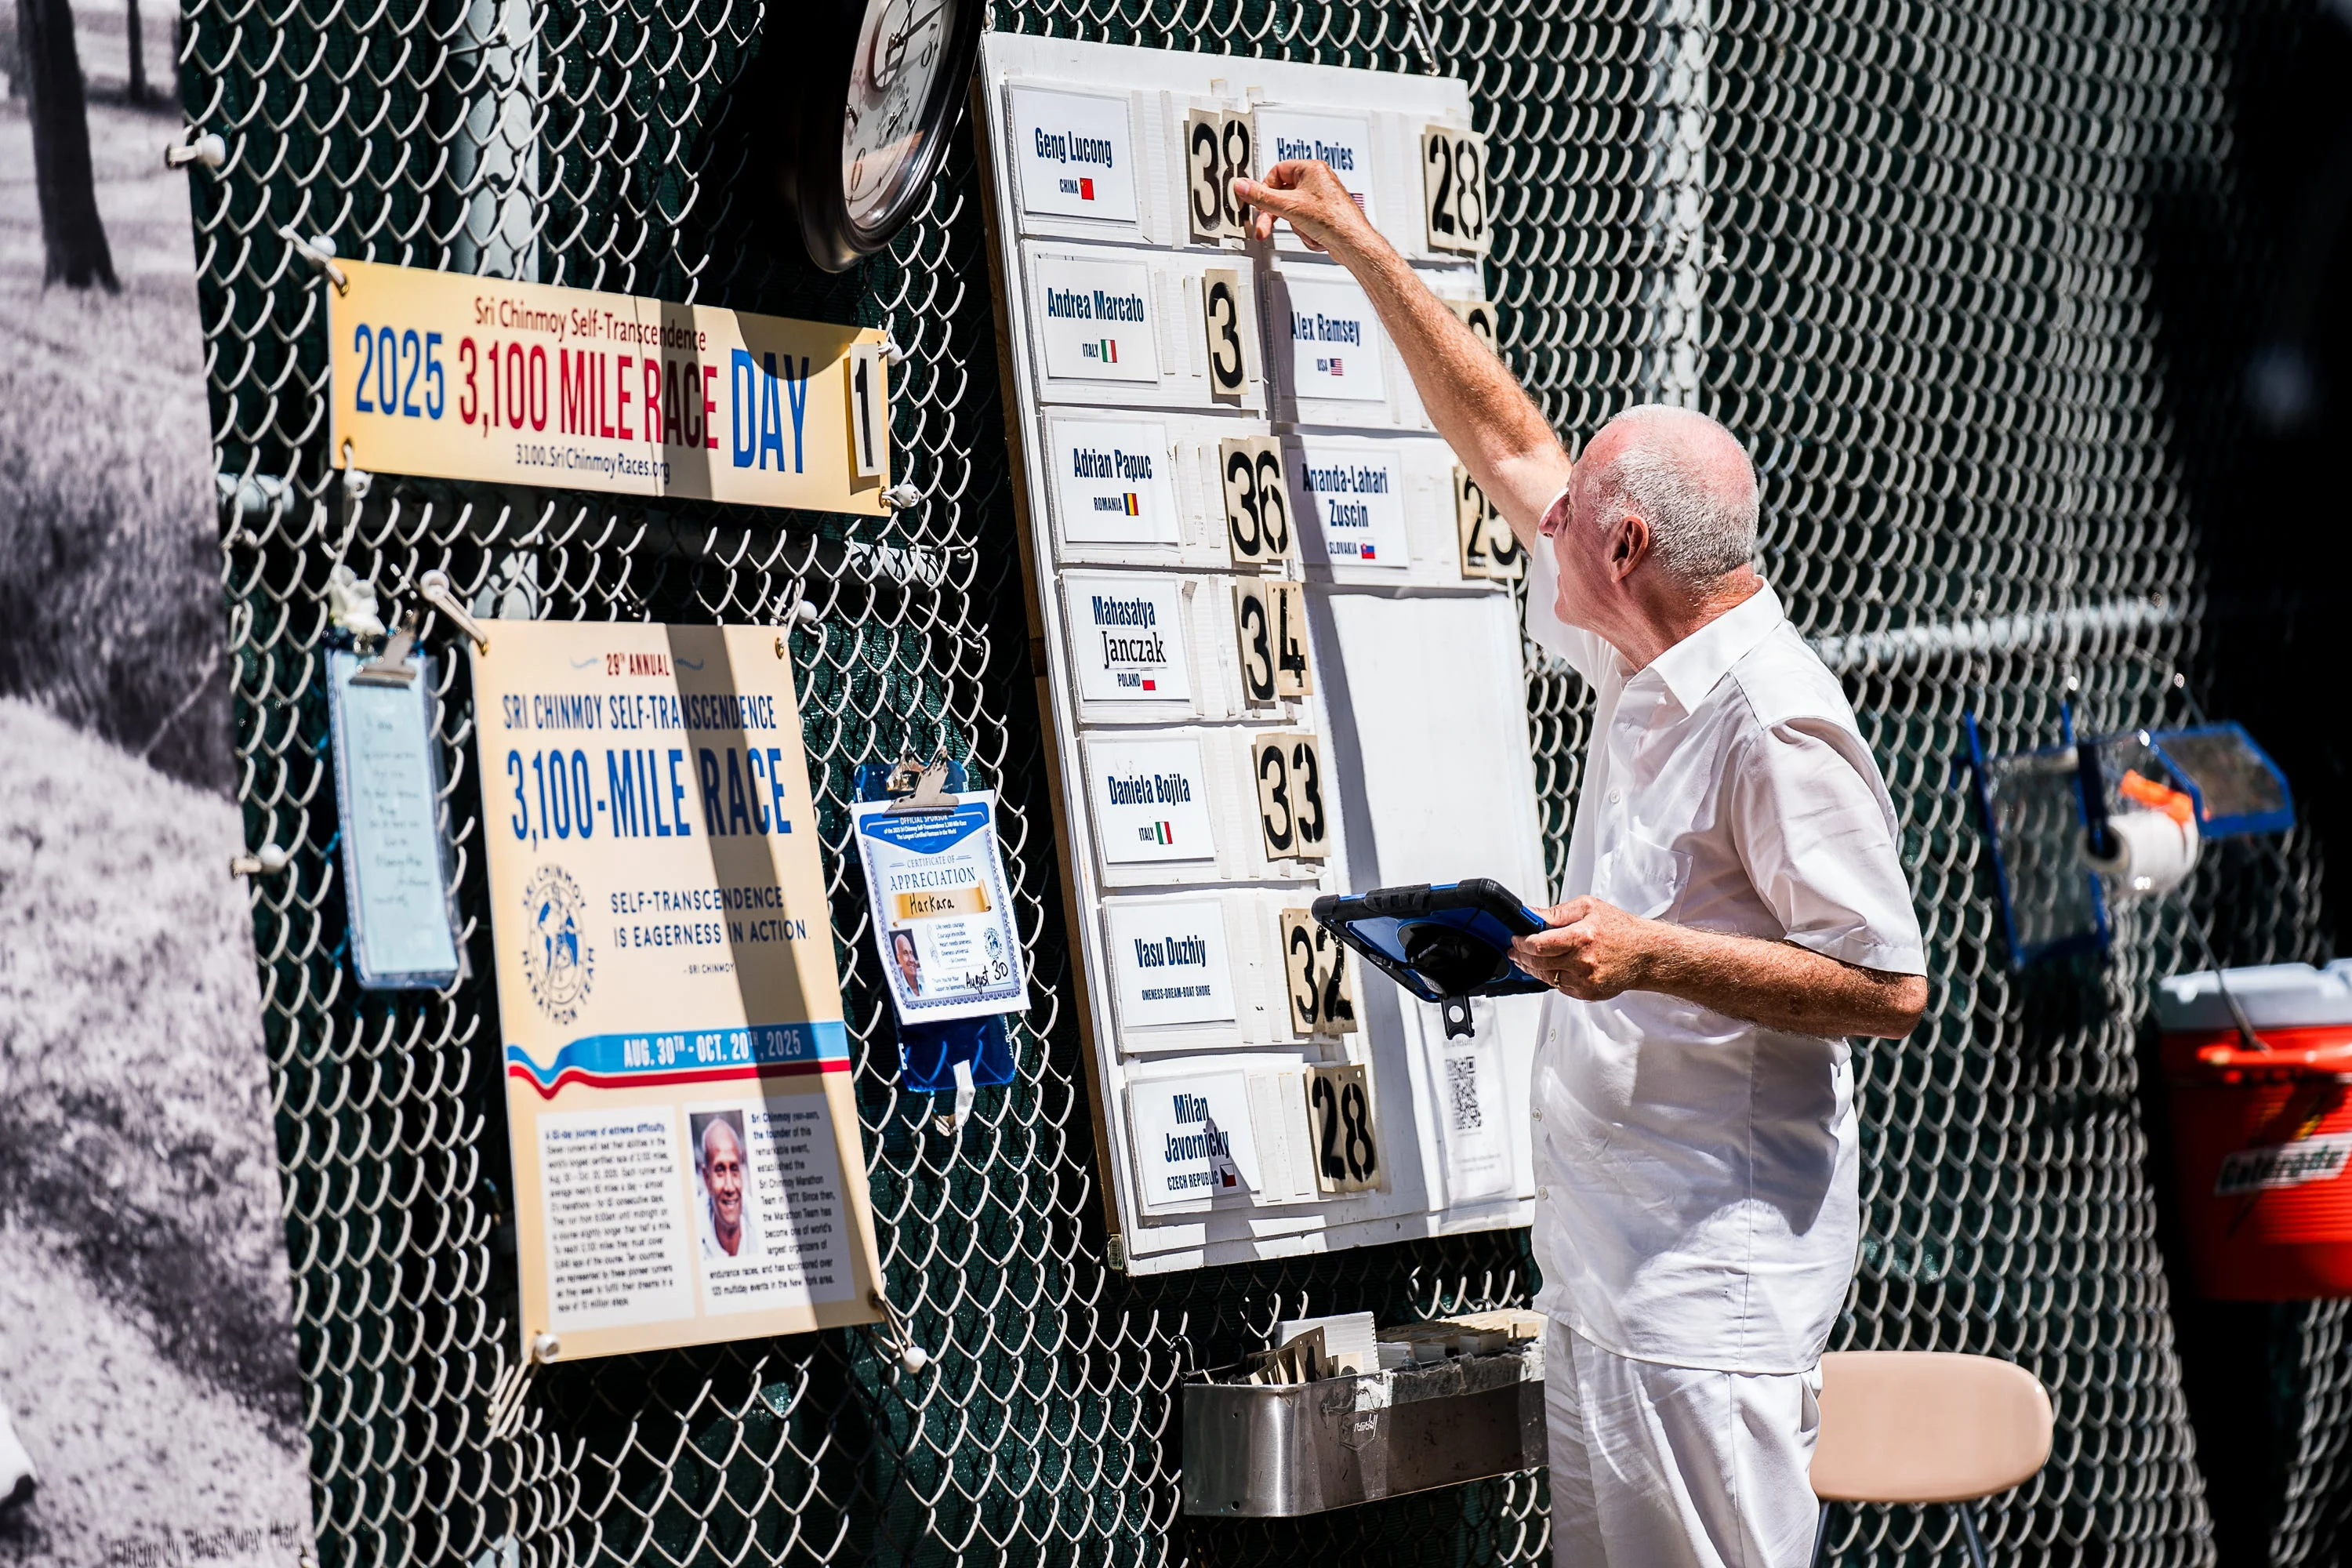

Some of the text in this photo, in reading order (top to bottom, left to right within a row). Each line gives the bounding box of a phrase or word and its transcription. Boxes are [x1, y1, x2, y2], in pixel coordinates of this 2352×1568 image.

[1035, 127, 1112, 169] Geng Lucong
[1276, 137, 1354, 170] Harita Davies
[1059, 178, 1079, 194] CHINA
[1192, 119, 1251, 232] 38
[1428, 134, 1483, 241] 28
[1047, 287, 1145, 322] Andrea Marcato
[474, 296, 707, 352] Sri Chinmoy Self-Transcendence
[1208, 281, 1243, 388] 3
[1290, 311, 1361, 347] Alex Ramsey
[1082, 343, 1098, 358] ITALY
[354, 322, 875, 474] 2025 3,100 MILE RACE DAY 1
[1073, 448, 1152, 483] Adrian Papuc
[1302, 463, 1388, 493] Ananda-Lahari
[1094, 497, 1123, 512] ROMANIA
[1228, 450, 1289, 557] 36
[1329, 499, 1369, 527] Zuscin
[1329, 542, 1358, 555] SLOVAKIA
[1092, 596, 1156, 629] Mahasatya
[1102, 630, 1167, 668] Janczak
[1241, 588, 1307, 700] 34
[630, 653, 670, 677] ANNUAL
[1117, 673, 1141, 688] POLAND
[503, 695, 777, 730] SRI CHINMOY SELF-TRANSCENDENCE
[507, 748, 691, 851] 3,100-MILE
[699, 747, 793, 837] RACE
[1108, 773, 1191, 807] Daniela Bojila
[1259, 742, 1326, 851] 33
[899, 816, 924, 826] OFFICIAL
[1138, 826, 1155, 842] ITALY
[907, 855, 956, 868] CERTIFICATE OF
[891, 866, 976, 891] APPRECIATION
[612, 887, 784, 914] SELF-TRANSCENDENCE
[614, 919, 811, 948] IS EAGERNESS IN ACTION.
[702, 962, 735, 974] CHINMOY
[1134, 935, 1207, 968] Vasu Duzhiy
[992, 960, 1008, 981] 30
[1290, 925, 1355, 1025] 32
[1142, 985, 1211, 1001] ONENESS-DREAM-BOAT SHORE
[624, 1038, 655, 1068] AUG.
[696, 1034, 728, 1063] OCT.
[766, 1029, 801, 1058] 2025
[1173, 1093, 1210, 1124] Milan
[1164, 1127, 1229, 1163] Javornicky
[1312, 1076, 1376, 1183] 28
[1167, 1171, 1219, 1191] CZECH REPUBLIC
